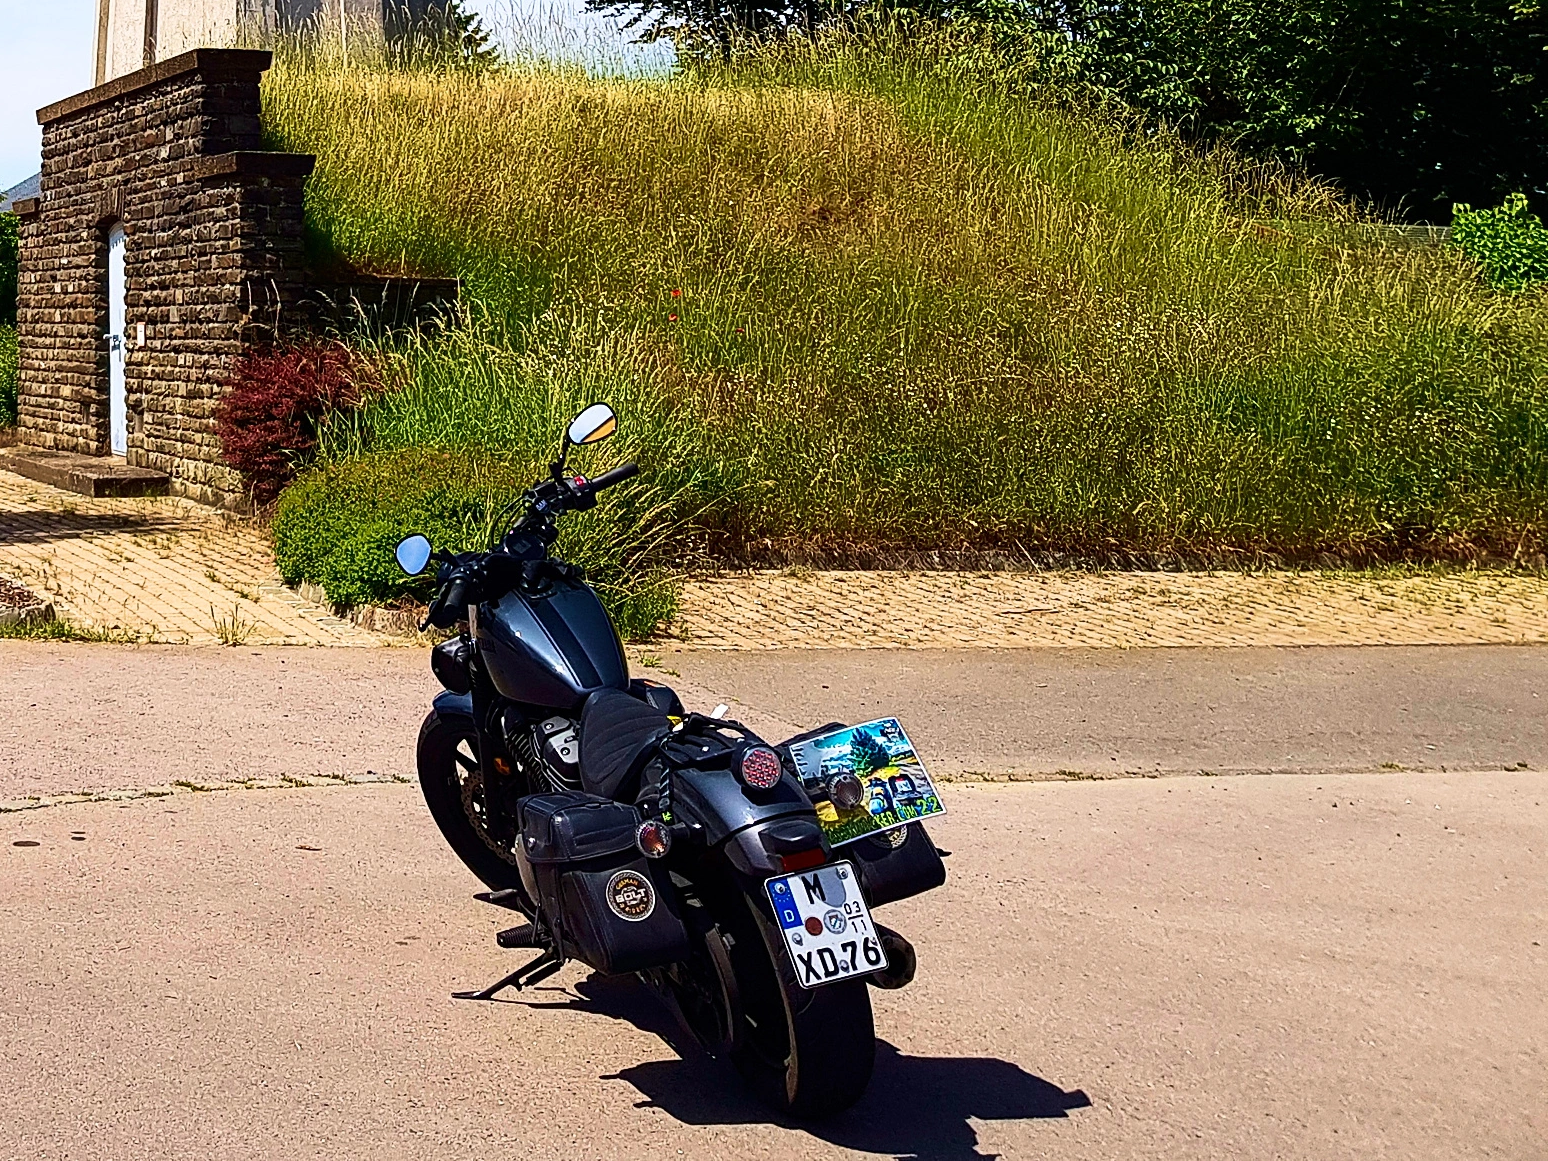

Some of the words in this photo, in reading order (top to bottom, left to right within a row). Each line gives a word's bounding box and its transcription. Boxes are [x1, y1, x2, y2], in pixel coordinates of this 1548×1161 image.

[614, 888, 646, 903] BOLT
[801, 873, 826, 904] M
[843, 900, 861, 915] 03
[783, 909, 795, 922] D
[851, 919, 867, 933] 11
